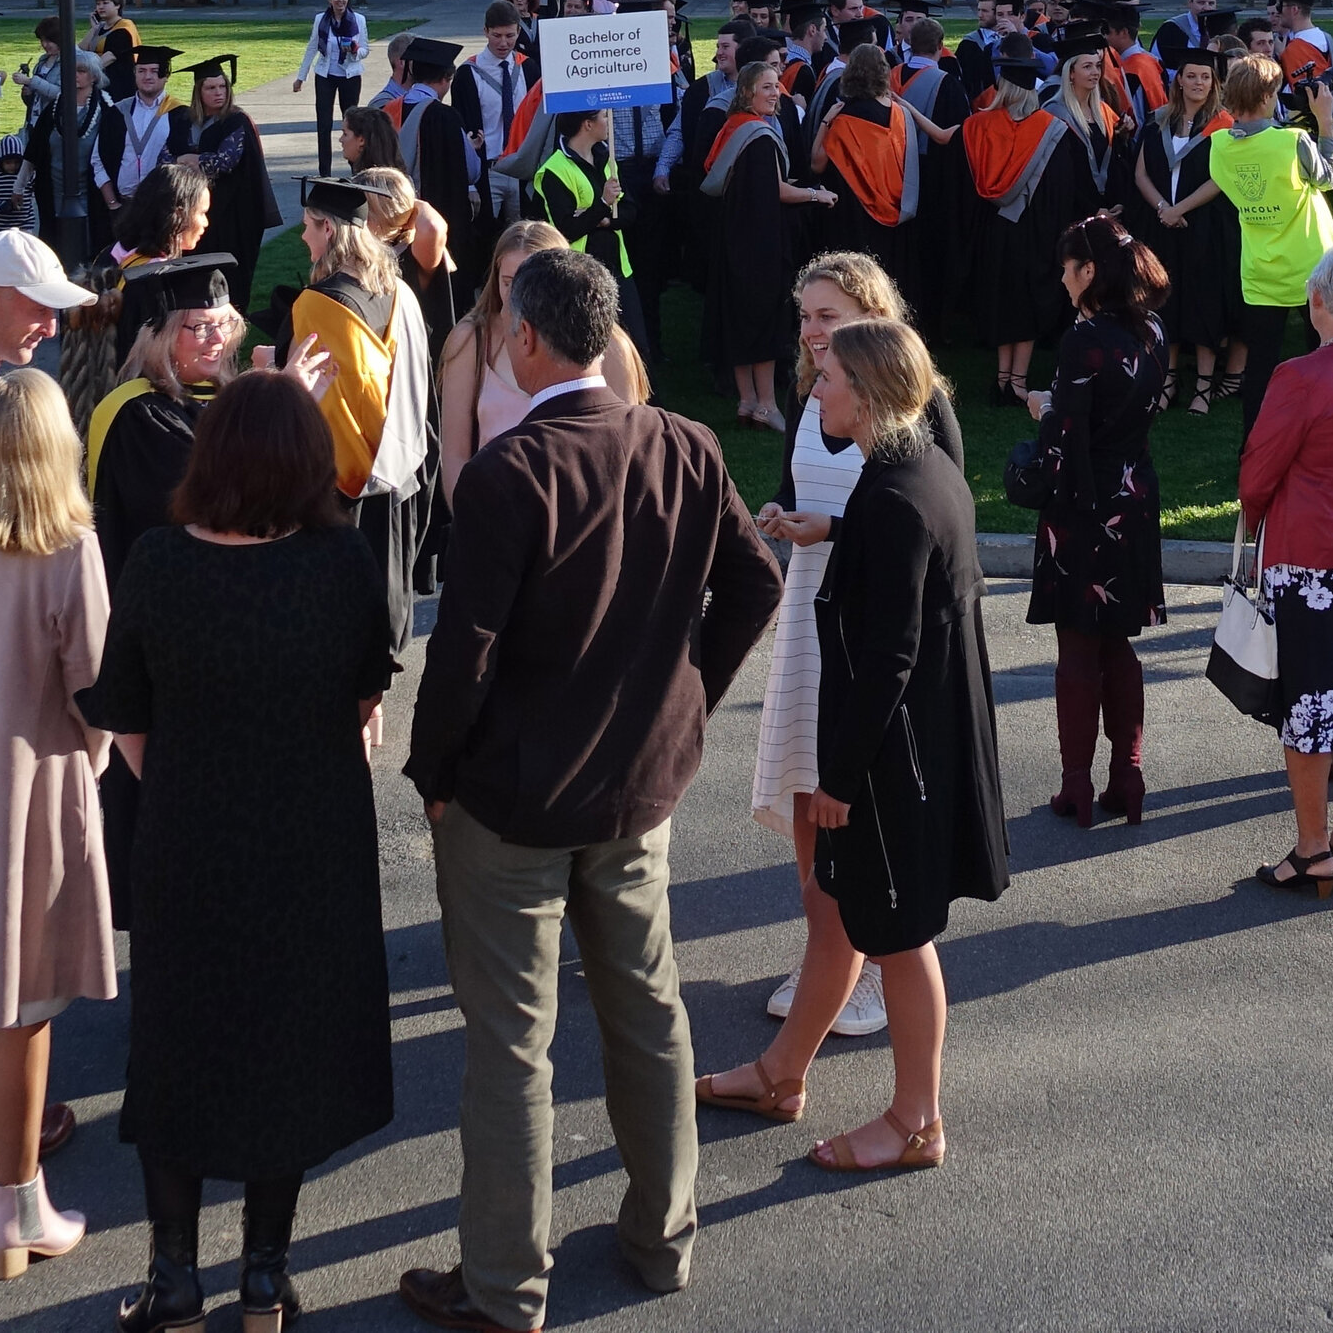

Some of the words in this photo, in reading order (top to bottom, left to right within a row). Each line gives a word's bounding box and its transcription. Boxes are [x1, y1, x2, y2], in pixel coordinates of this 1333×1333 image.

[569, 31, 624, 45] Bachelor
[628, 28, 641, 40] of
[571, 47, 641, 60] Commerce
[566, 59, 648, 78] (Agriculture)
[1240, 205, 1281, 214] INCOLN
